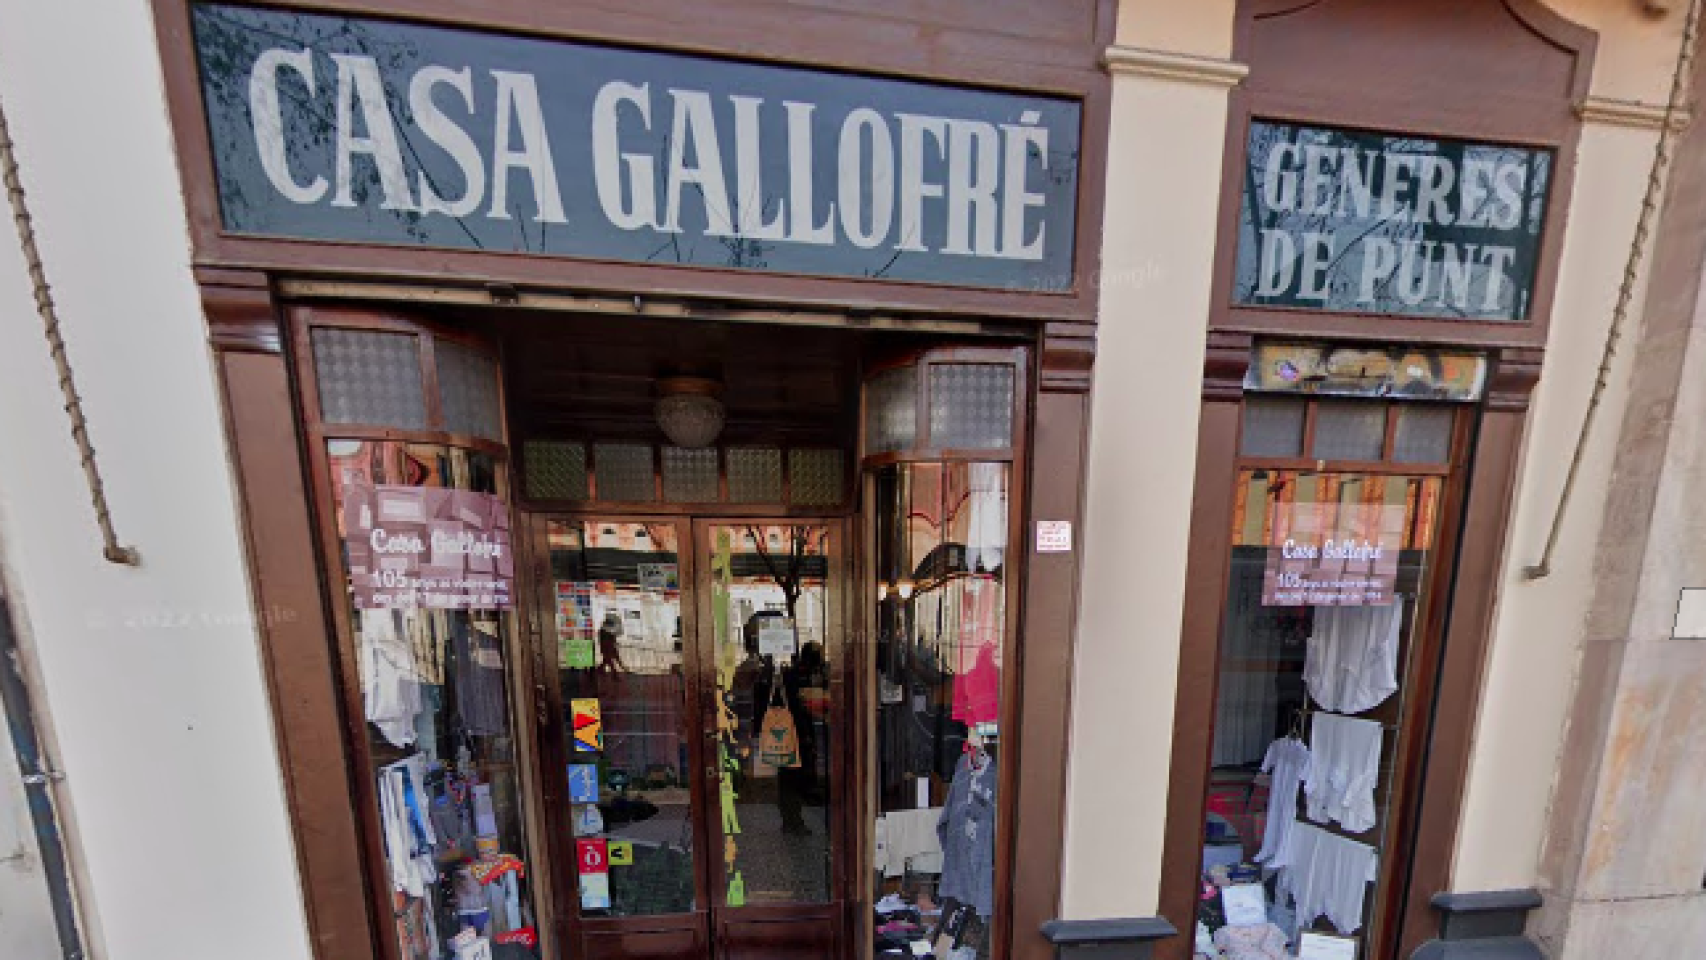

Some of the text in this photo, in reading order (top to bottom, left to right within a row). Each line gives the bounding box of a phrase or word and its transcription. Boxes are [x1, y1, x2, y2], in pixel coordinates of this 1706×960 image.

[248, 47, 1049, 262] CASA GALLOFRÉ
[1254, 228, 1517, 311] DE PUNT
[370, 528, 427, 554] Casa
[1282, 538, 1318, 559] Casa
